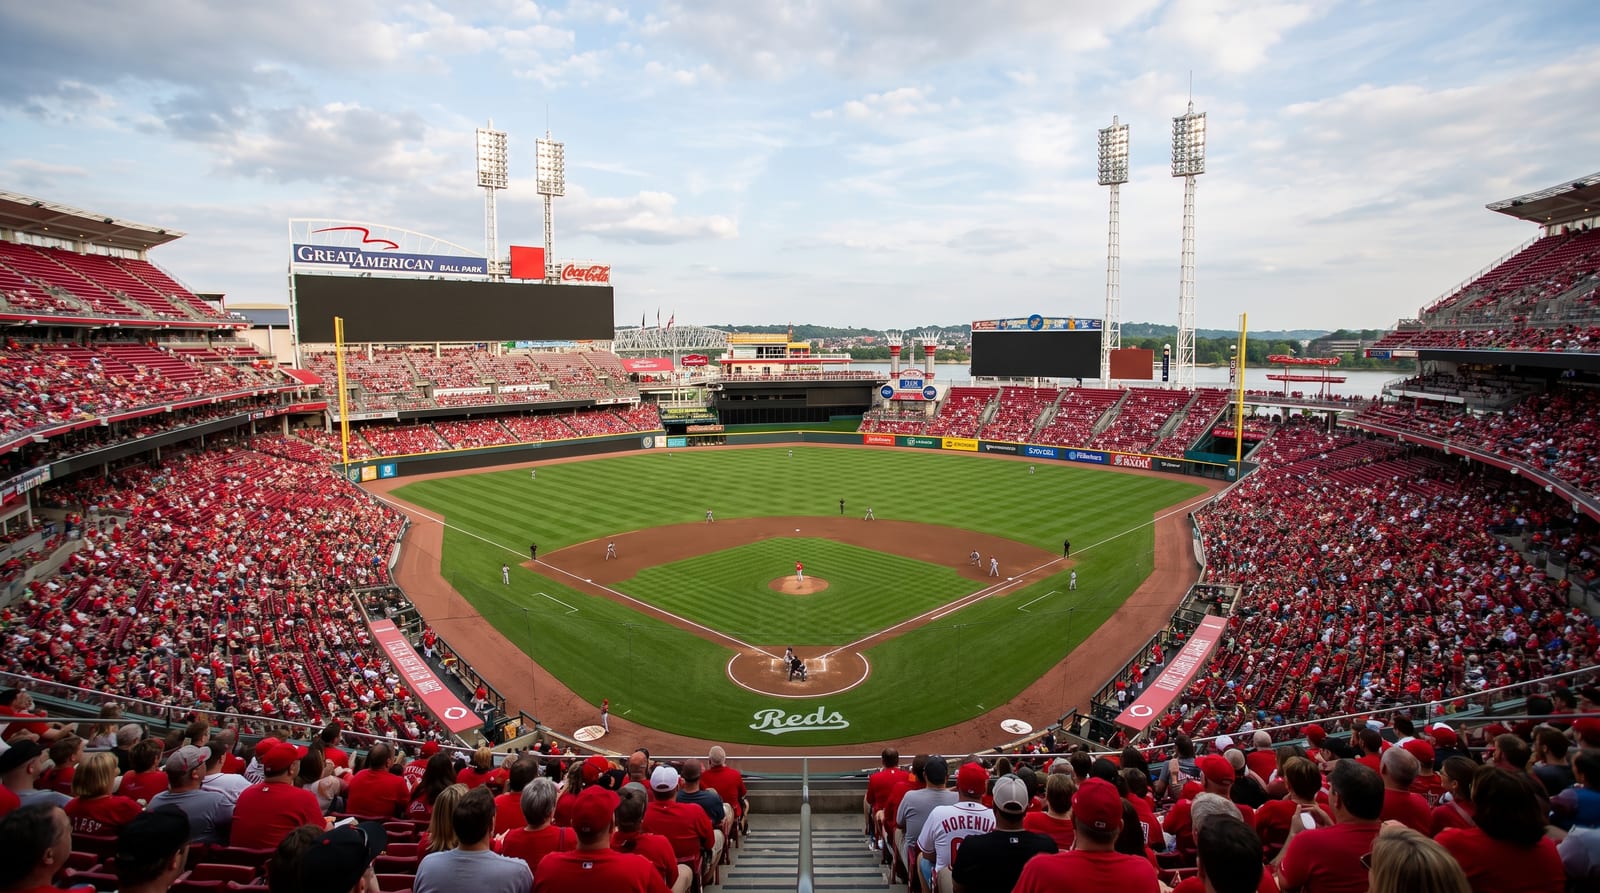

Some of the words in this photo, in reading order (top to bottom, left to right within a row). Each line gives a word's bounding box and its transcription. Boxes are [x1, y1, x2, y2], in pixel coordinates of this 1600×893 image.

[297, 246, 356, 263] GREAT
[352, 253, 434, 271] AMERICAN
[439, 264, 459, 273] BALL
[461, 265, 482, 274] PARK
[749, 706, 850, 735] Reds
